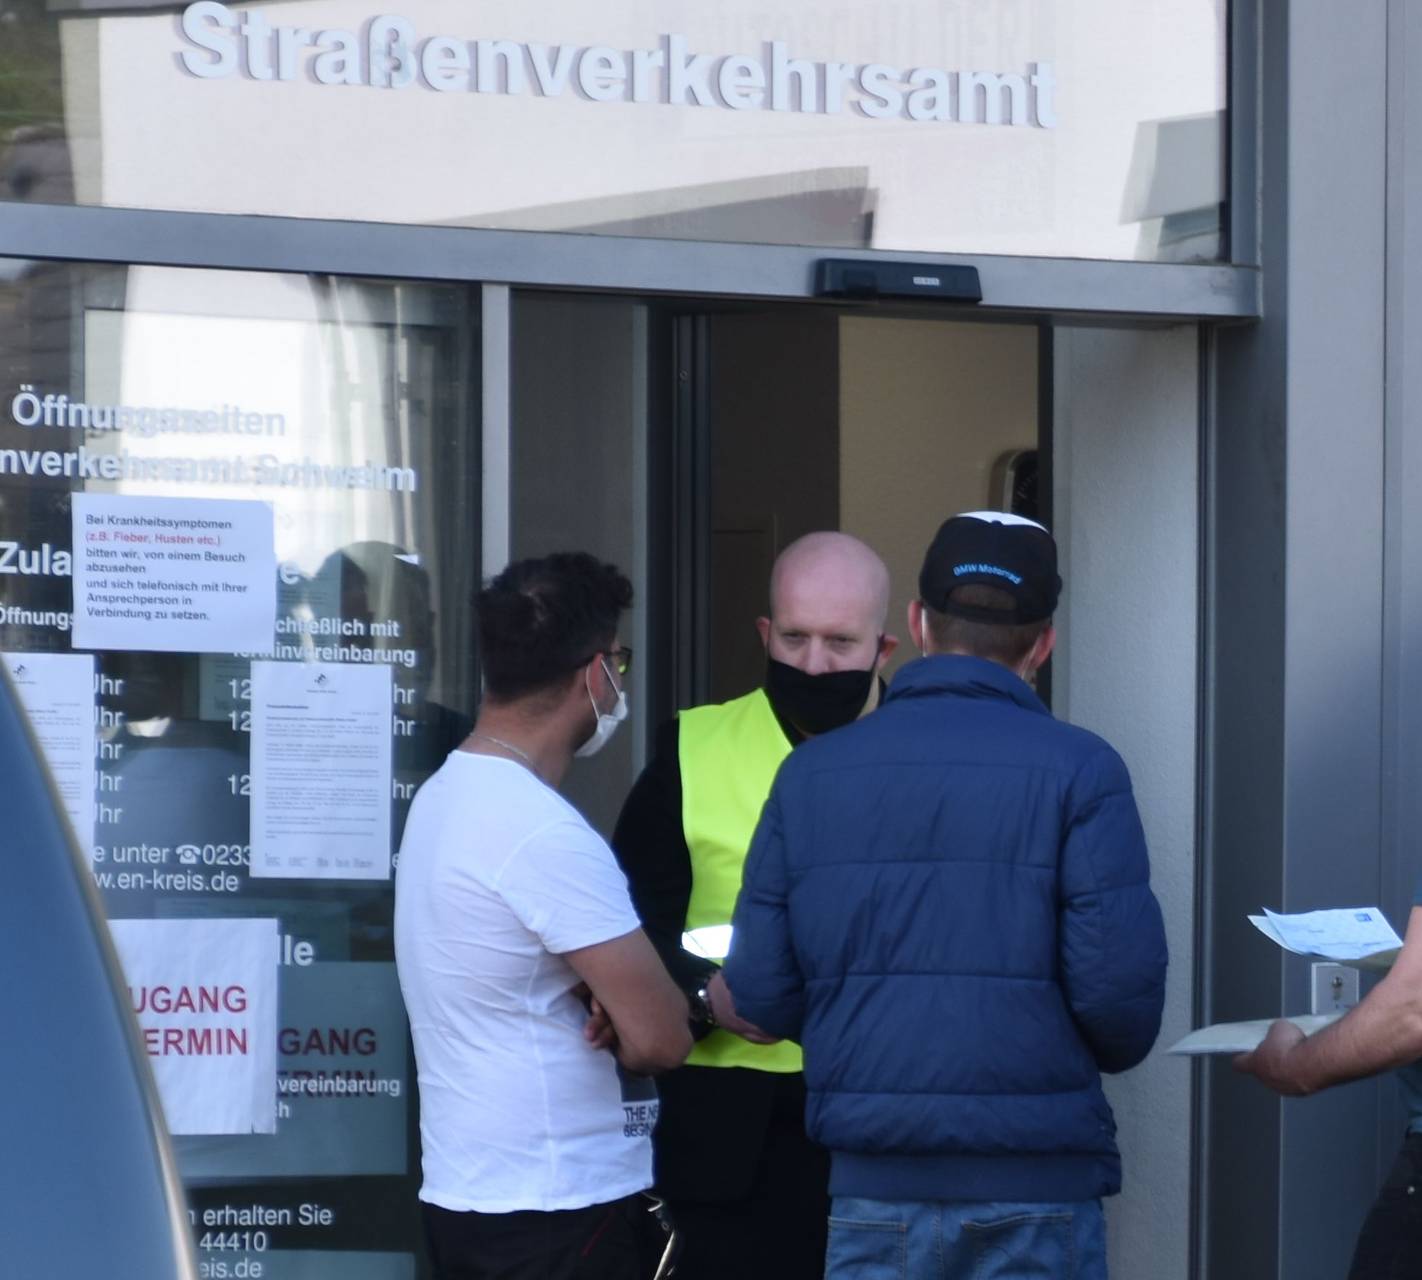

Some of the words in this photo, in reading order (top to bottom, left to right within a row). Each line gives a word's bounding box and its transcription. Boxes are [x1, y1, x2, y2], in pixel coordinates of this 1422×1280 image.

[178, 2, 1056, 129] Straßenverkehrsamt
[11, 384, 286, 437] Öffnungszeiten
[86, 514, 104, 525] Bei
[107, 515, 232, 530] Krankheitssymptomen
[155, 534, 194, 545] Husten
[86, 547, 118, 559] bitten
[144, 551, 165, 561] von
[168, 550, 201, 562] einem
[204, 551, 246, 563] Besuch
[86, 562, 147, 574] abzusehen
[953, 563, 978, 577] BMW
[86, 578, 108, 589] und
[111, 579, 134, 590] sich
[137, 580, 198, 592] telefonisch
[201, 581, 219, 593] mit
[222, 582, 248, 593] Ihrer
[87, 592, 179, 607] Ansprechperson
[182, 594, 193, 606] in
[86, 606, 152, 621] Verbindung
[154, 611, 168, 620] zu
[171, 609, 211, 621] setzen.
[370, 619, 401, 637] mit
[112, 843, 170, 864] unter
[278, 1074, 401, 1097] vereinbarung
[623, 1106, 646, 1122] THE
[203, 1204, 291, 1226] erhalten
[298, 1203, 333, 1226] Sie
